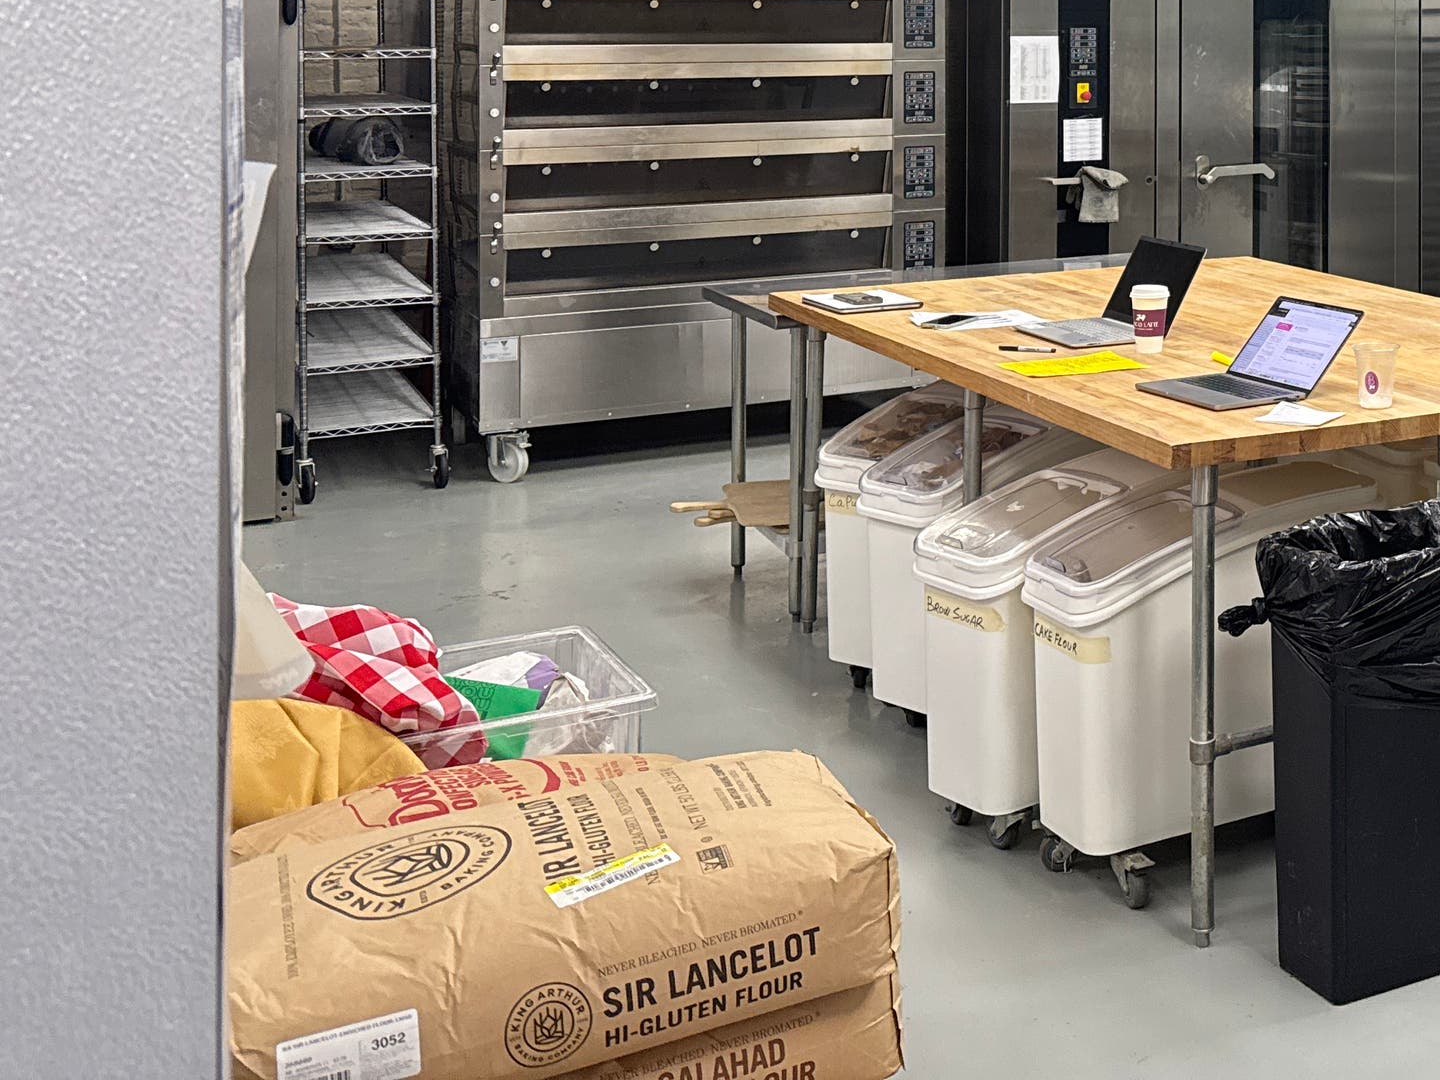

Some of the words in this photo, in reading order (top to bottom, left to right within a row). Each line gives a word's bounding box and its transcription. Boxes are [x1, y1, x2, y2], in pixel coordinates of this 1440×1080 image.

[953, 607, 985, 629] SUGAR
[1035, 622, 1053, 642] CAKE
[1054, 633, 1077, 655] FLOUR
[517, 797, 574, 856] LANCELOT
[577, 812, 616, 868] HI-GLUTEN
[688, 814, 709, 830] NET
[440, 849, 494, 891] BAKING
[543, 855, 581, 882] IR
[334, 890, 406, 913] KING
[598, 959, 637, 978] NEVER
[701, 929, 738, 948] NEVER
[602, 977, 658, 1018] SIR
[668, 926, 821, 999] LANCELOT
[510, 998, 534, 1033] KING
[537, 988, 585, 1015] ARTHUR
[605, 994, 727, 1047] HI-GLUTEN
[735, 971, 803, 1007] FLOUR
[371, 1031, 406, 1051] 3052
[514, 1043, 544, 1062] BAKING
[547, 1027, 584, 1060] COMPANY
[658, 1038, 786, 1080] LAHAD
[711, 1035, 750, 1052] NEVER
